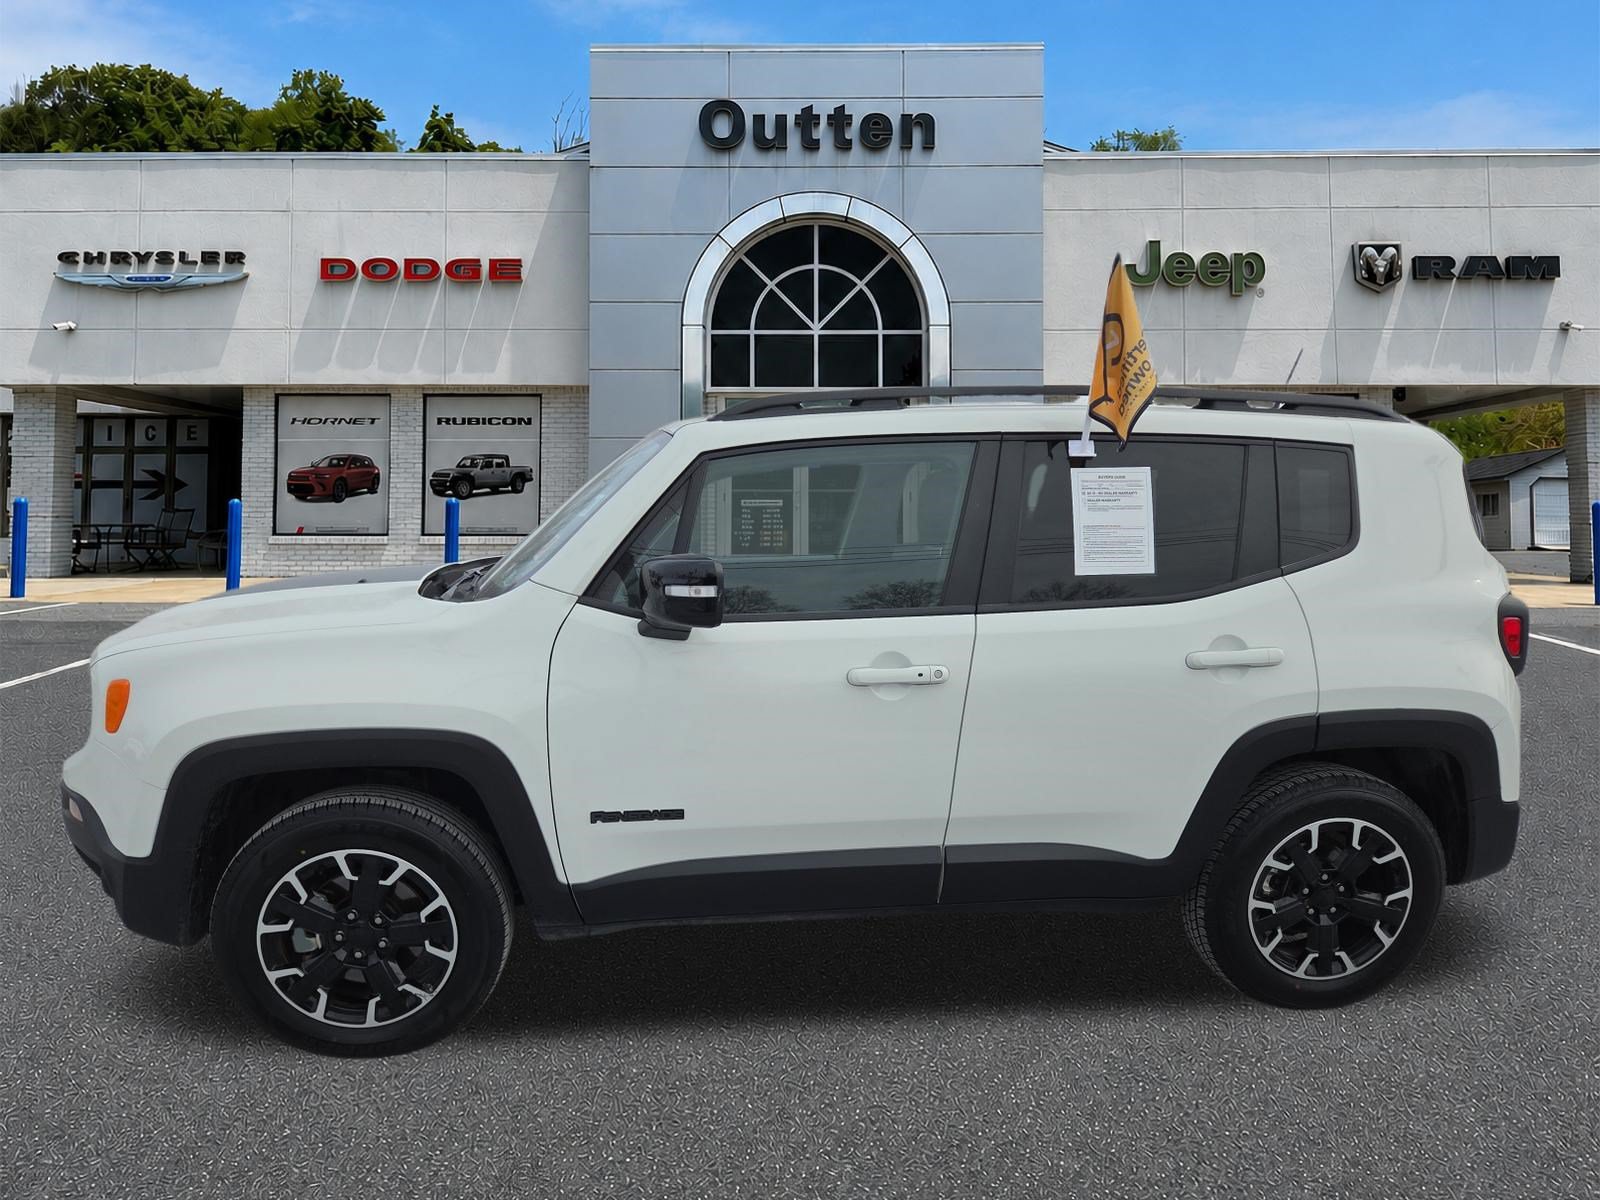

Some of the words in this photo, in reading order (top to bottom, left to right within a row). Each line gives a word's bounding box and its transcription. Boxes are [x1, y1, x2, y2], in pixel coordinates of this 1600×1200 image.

[699, 99, 936, 151] Outten
[57, 251, 247, 265] CHRYSLER
[320, 257, 523, 282] DODGE
[1124, 239, 1266, 297] Jeep
[1411, 255, 1561, 280] RAM
[290, 416, 381, 426] HORNET
[436, 416, 533, 426] RUBICON
